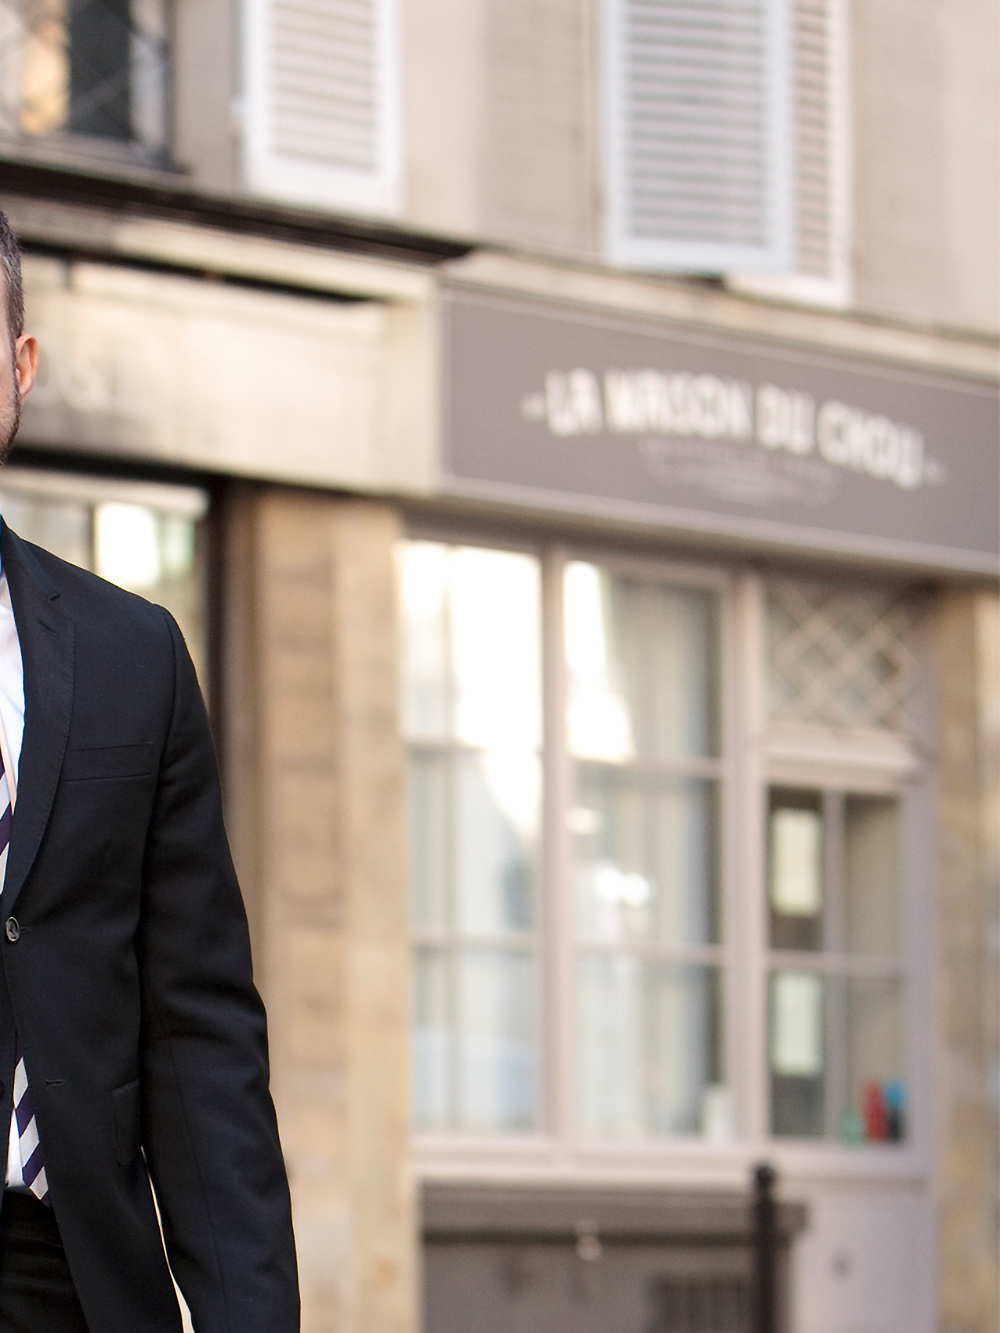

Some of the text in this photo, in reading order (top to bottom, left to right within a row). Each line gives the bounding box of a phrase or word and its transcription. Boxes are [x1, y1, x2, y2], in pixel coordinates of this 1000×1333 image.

[545, 368, 602, 436] LA
[604, 367, 753, 441] MAISON
[756, 382, 814, 455] DU
